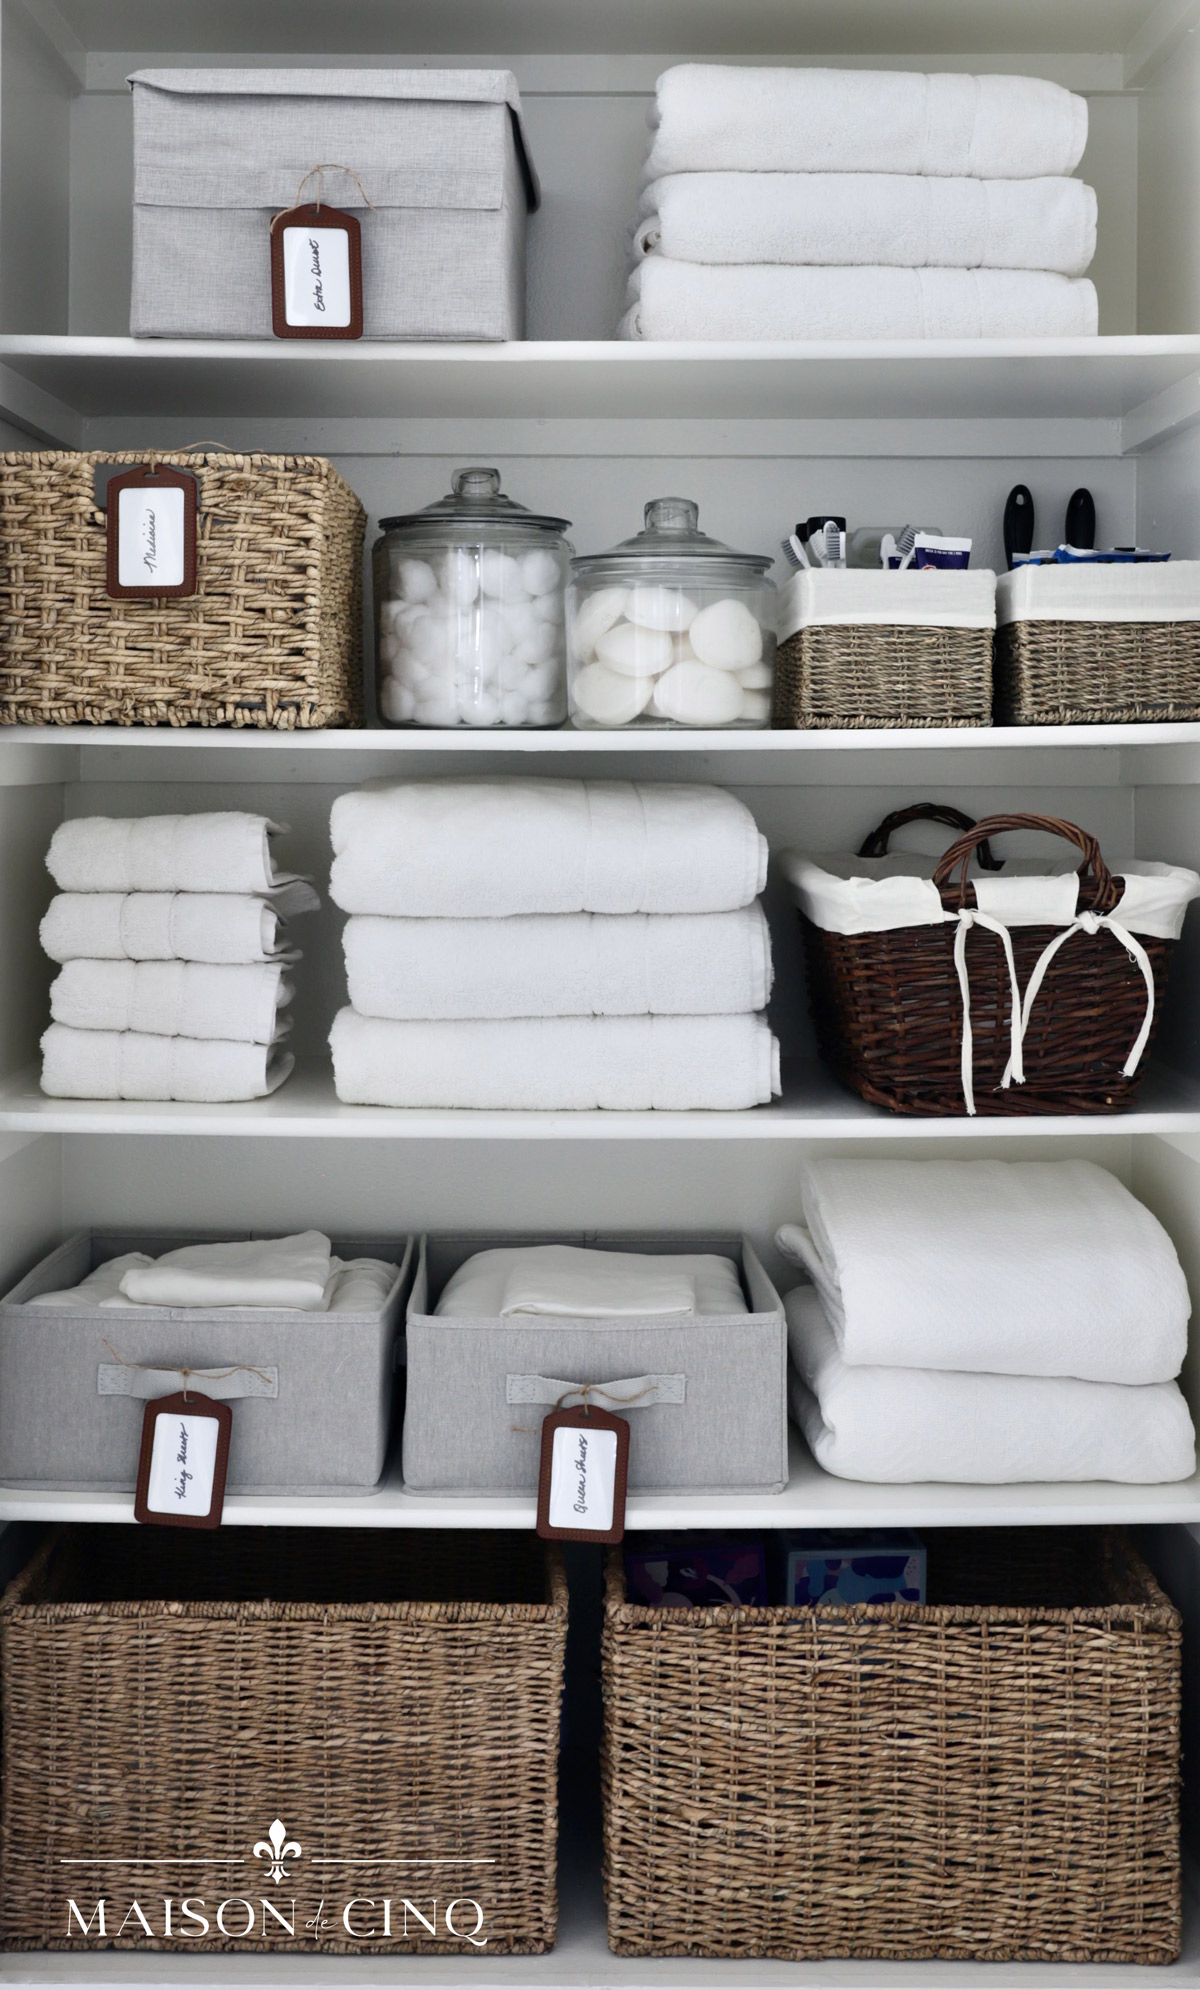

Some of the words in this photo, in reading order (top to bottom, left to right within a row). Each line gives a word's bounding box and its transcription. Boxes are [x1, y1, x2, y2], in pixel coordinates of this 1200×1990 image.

[312, 278, 326, 312] Extra
[142, 508, 158, 574] Medicine
[176, 1422, 189, 1465] Sheets
[574, 1433, 589, 1474] Sheets
[174, 1469, 193, 1500] King
[573, 1473, 589, 1514] Queen
